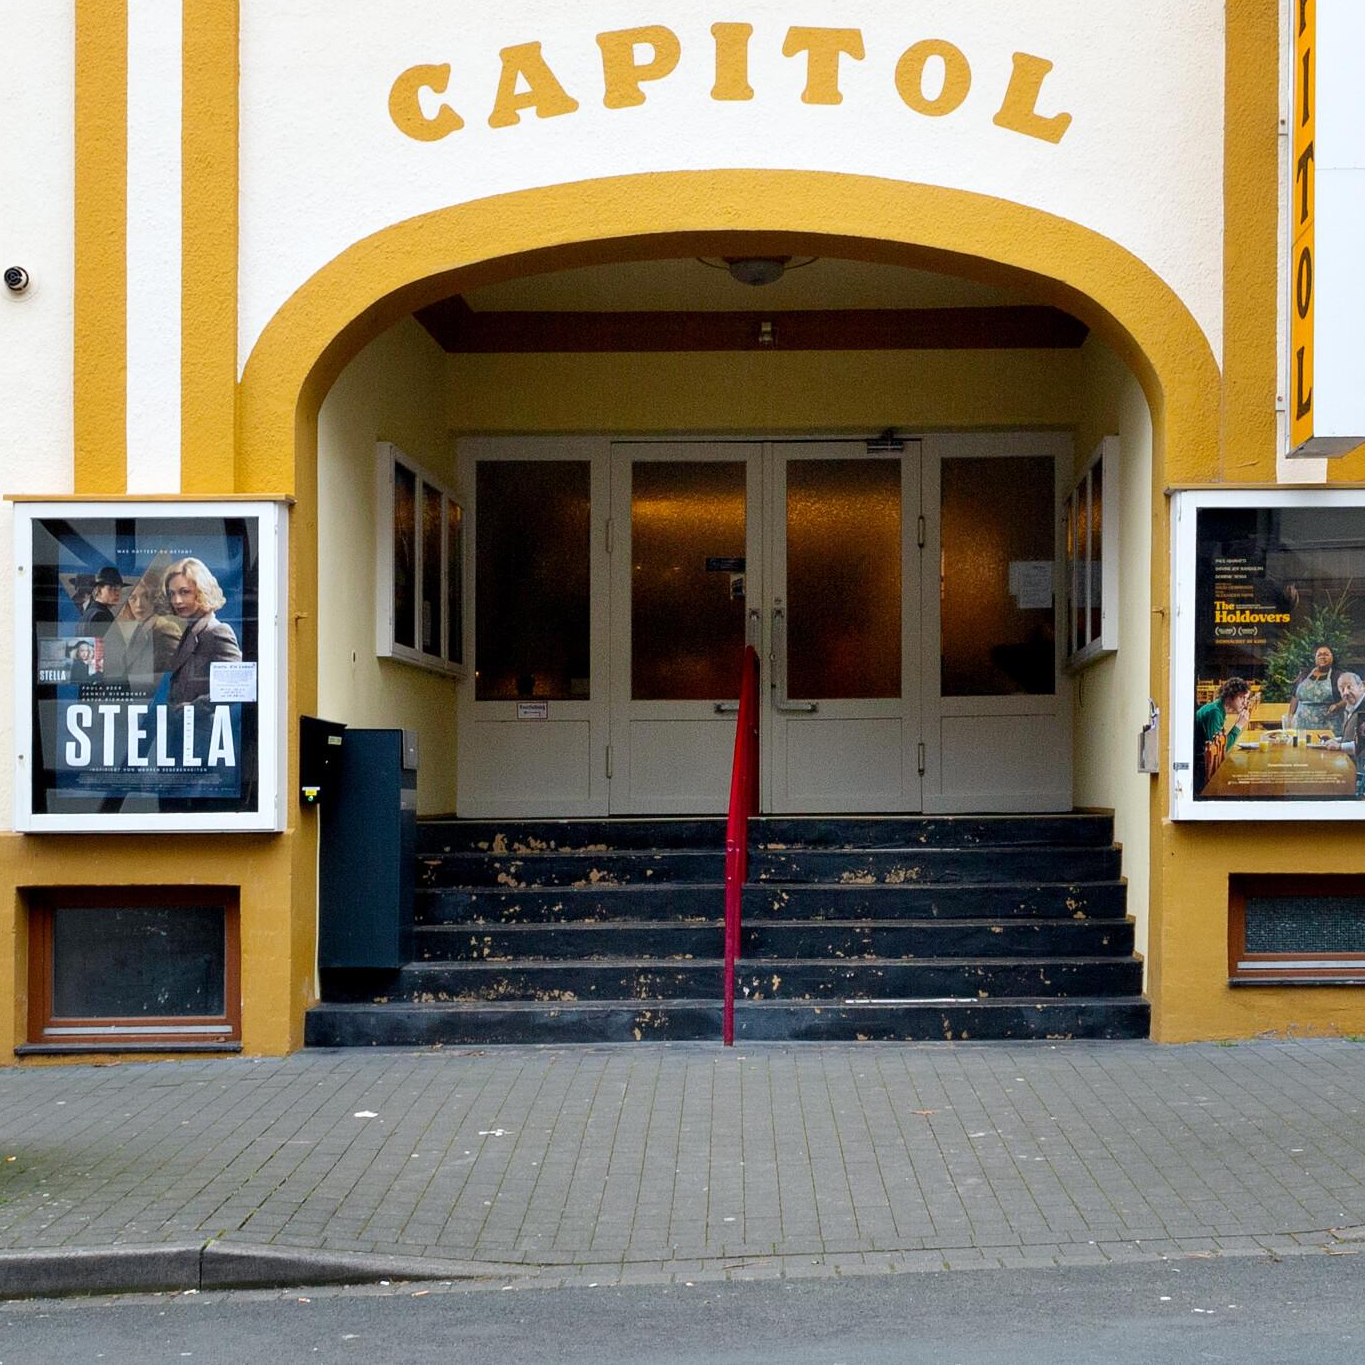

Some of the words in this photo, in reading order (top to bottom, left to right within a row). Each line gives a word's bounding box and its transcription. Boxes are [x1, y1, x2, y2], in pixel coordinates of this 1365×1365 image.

[388, 22, 1073, 144] CAPITOL
[1214, 601, 1235, 610] The
[1215, 610, 1291, 623] Holdovers
[39, 669, 66, 681] STELLA
[65, 705, 236, 766] STELLA
